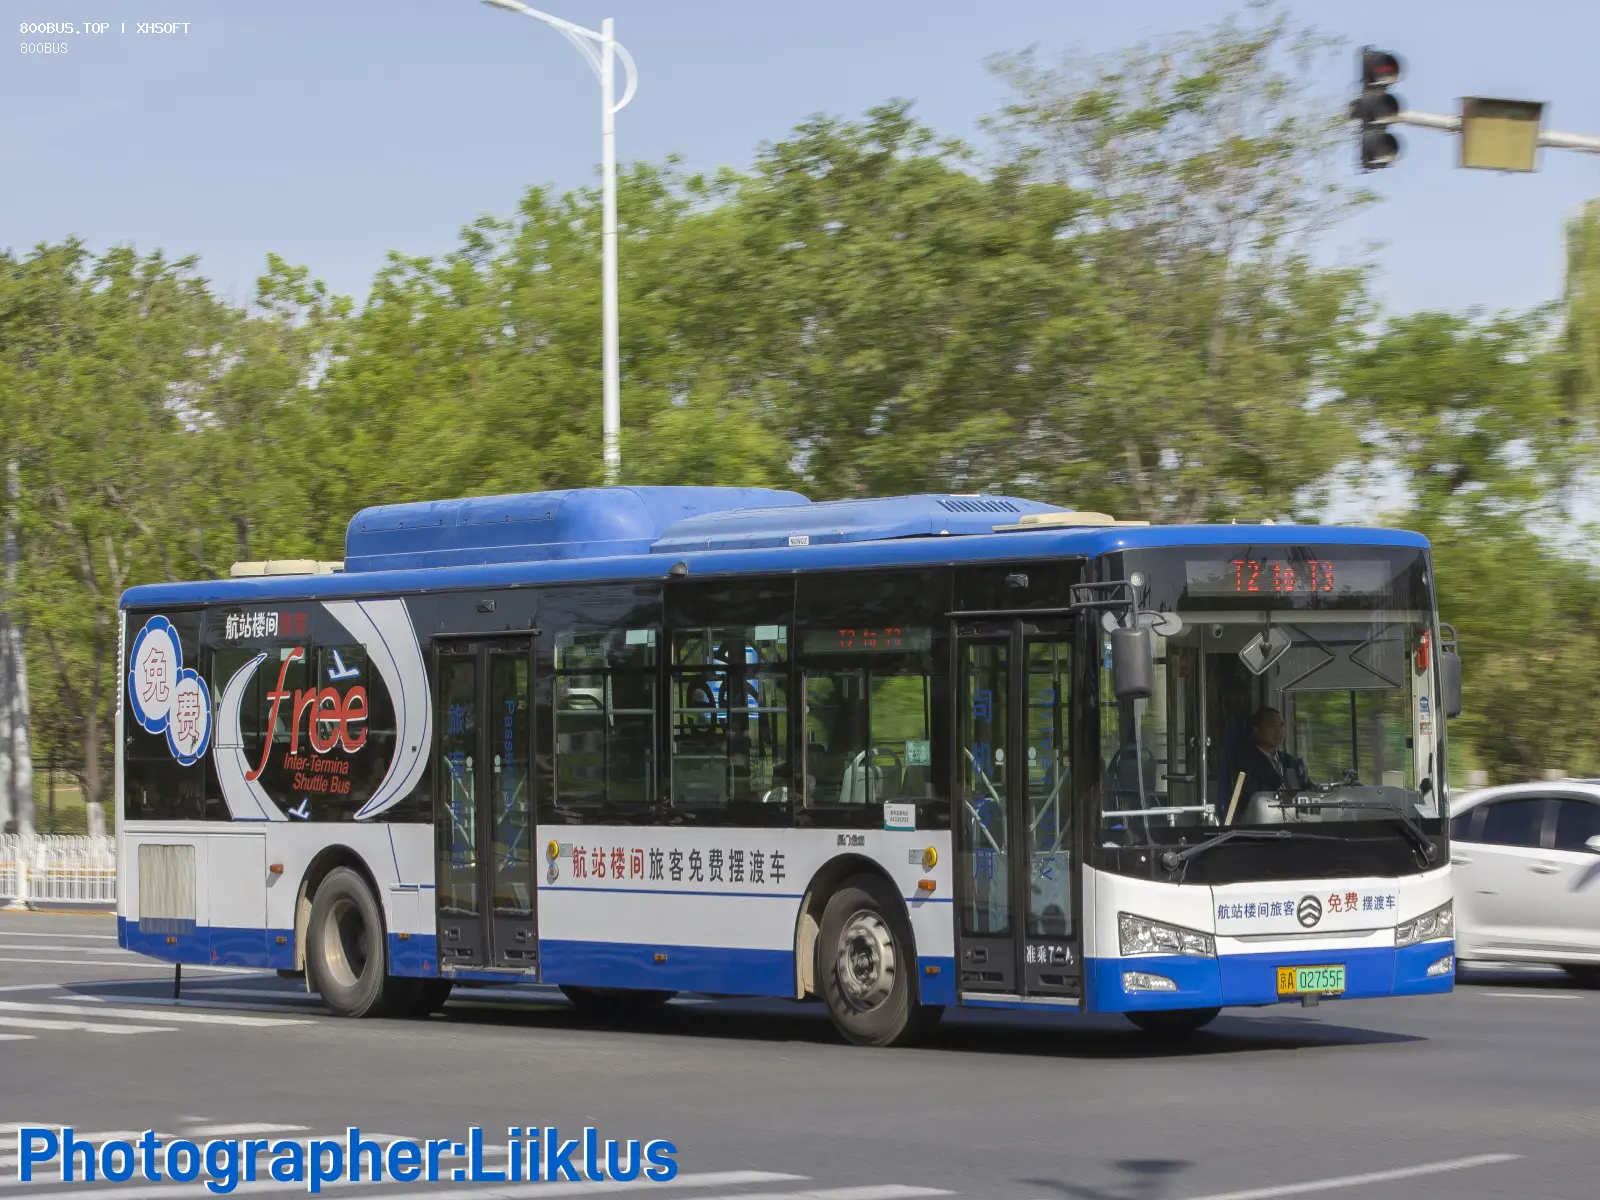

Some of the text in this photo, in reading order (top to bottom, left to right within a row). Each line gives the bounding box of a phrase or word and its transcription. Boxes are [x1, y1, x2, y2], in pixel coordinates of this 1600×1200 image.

[1233, 560, 1333, 591] T2 to T3
[245, 646, 368, 782] free
[293, 772, 351, 795] Shuttle Bus
[1217, 900, 1295, 920] 航站楼间旅客
[1327, 892, 1359, 913] 免费
[1299, 970, 1343, 988] 02755F
